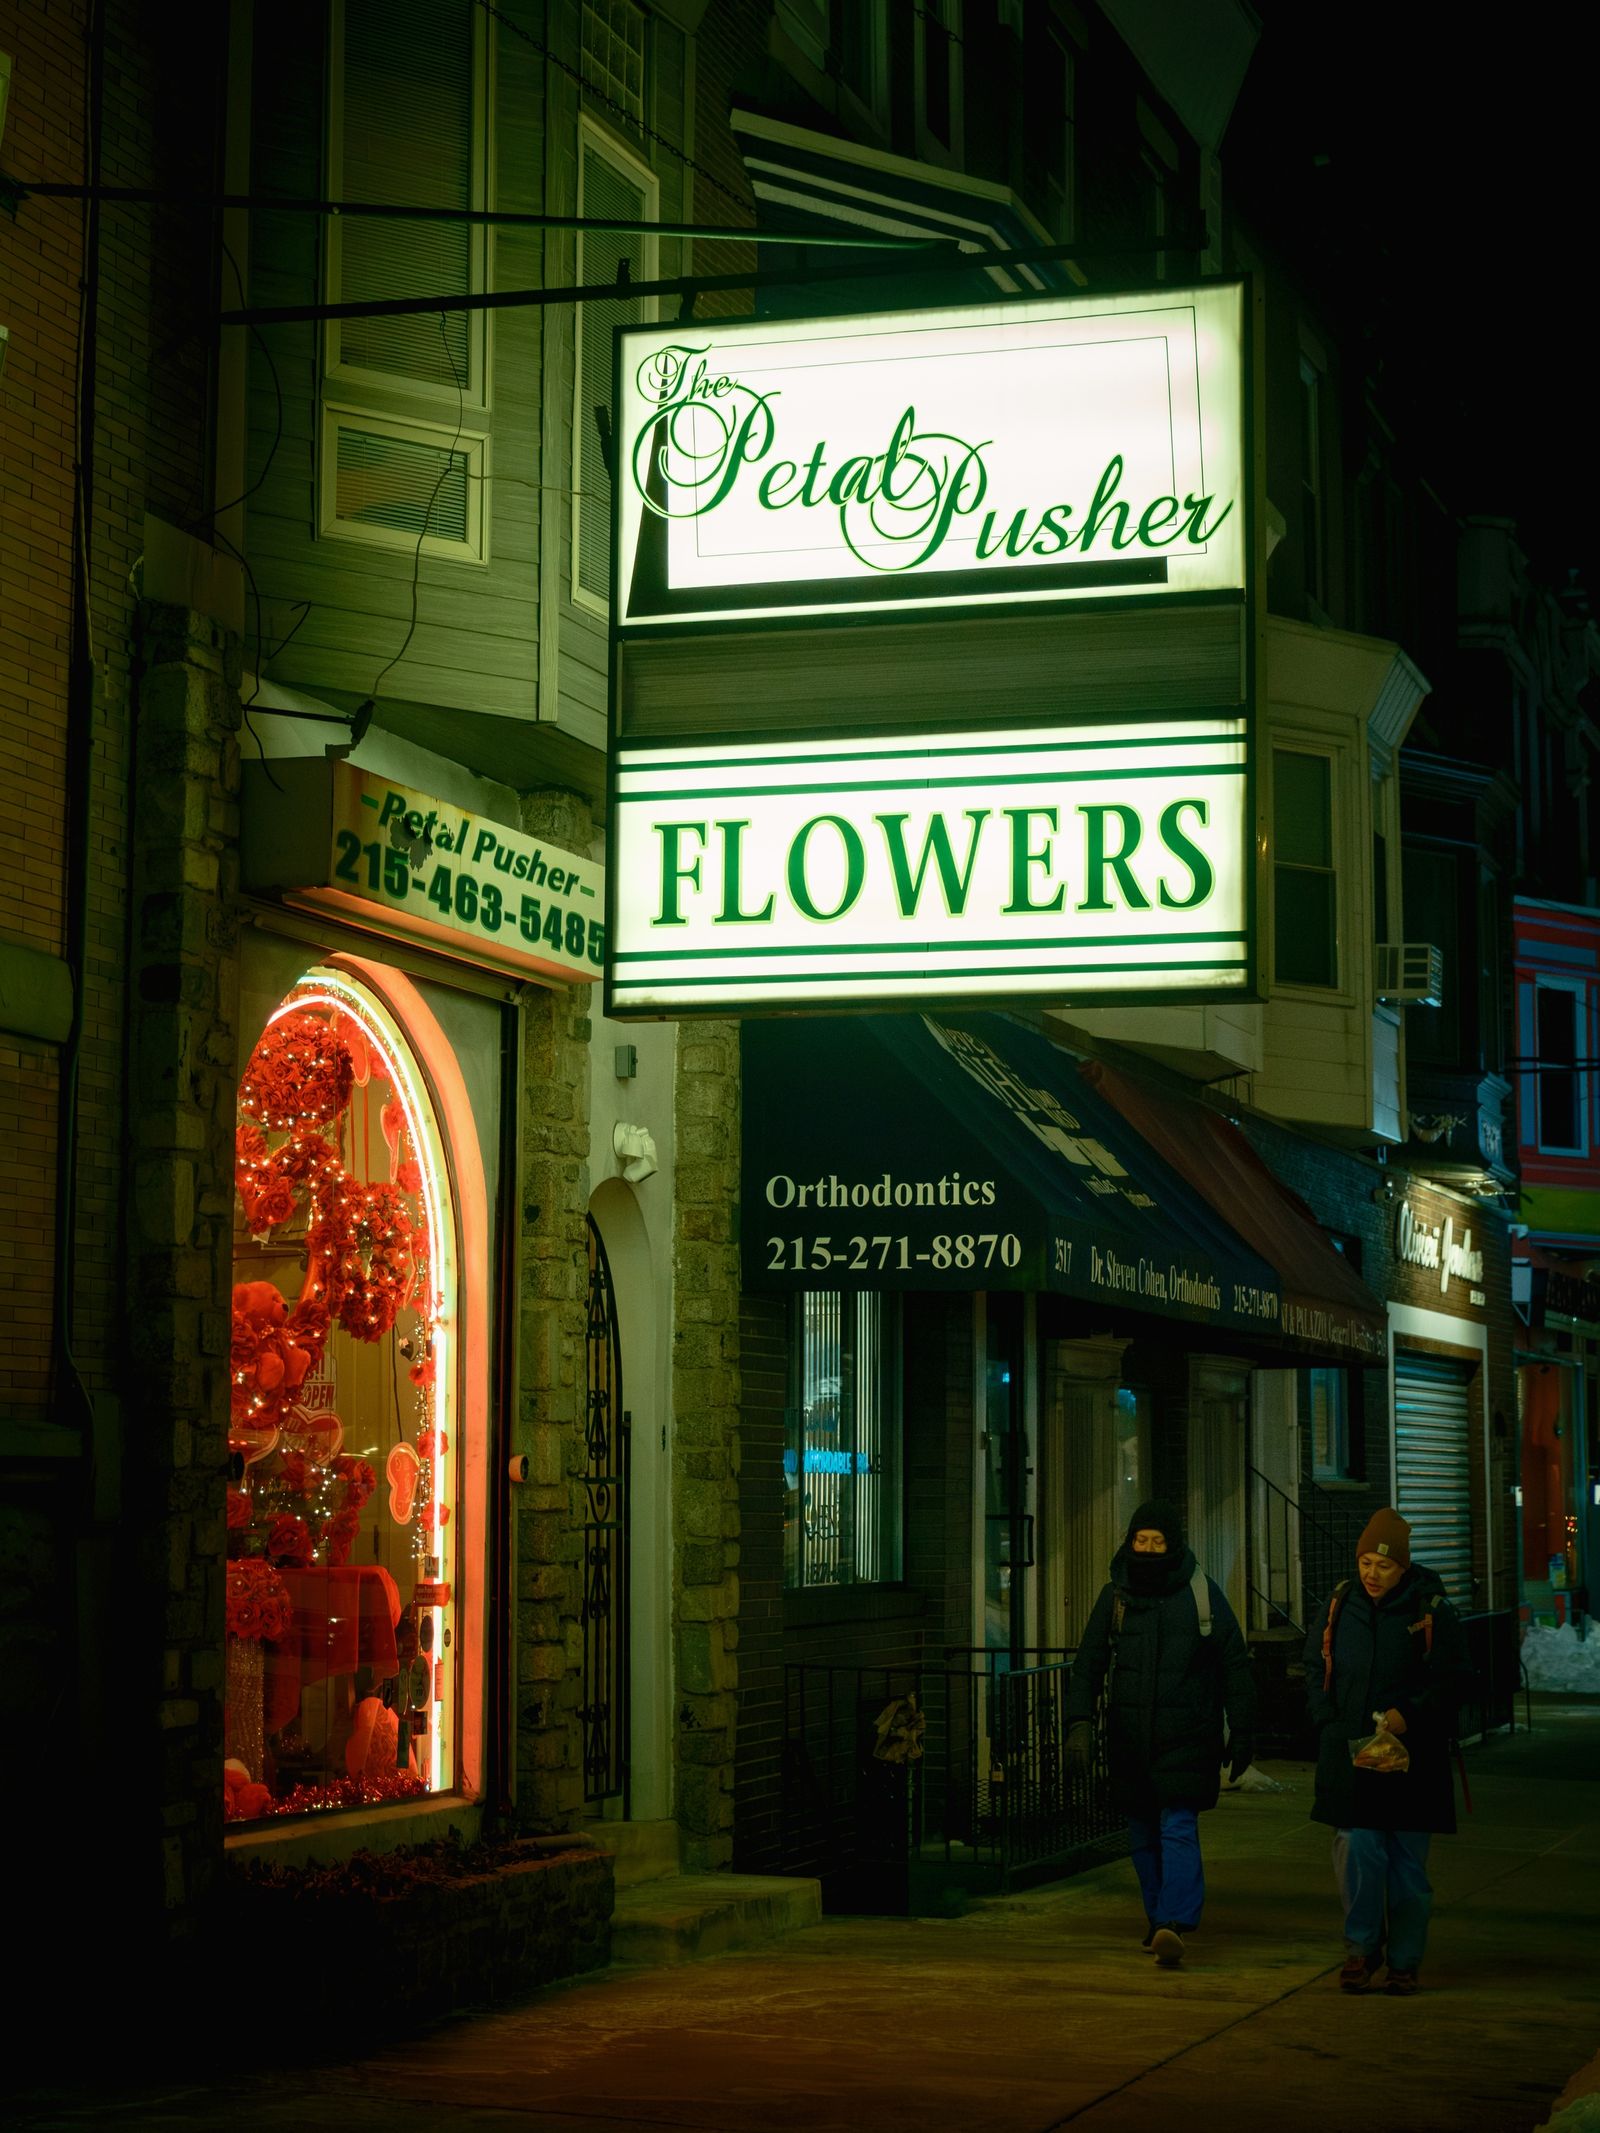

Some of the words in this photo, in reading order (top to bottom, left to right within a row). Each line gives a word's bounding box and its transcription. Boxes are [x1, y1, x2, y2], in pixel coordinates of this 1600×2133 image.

[636, 343, 738, 403] The
[632, 384, 932, 518] Petal
[841, 432, 1235, 572] Pusher
[335, 829, 605, 965] 215-463-5485
[649, 799, 1215, 929] FLOWERS
[765, 1171, 996, 1209] Orthodontics
[765, 1233, 1022, 1271] 215-271-8870
[1054, 1236, 1073, 1275] 2517
[1090, 1245, 1105, 1286] Dr.
[1106, 1249, 1137, 1293] Steven
[1169, 1264, 1221, 1311] Orthodontics
[303, 1384, 335, 1408] OPEN
